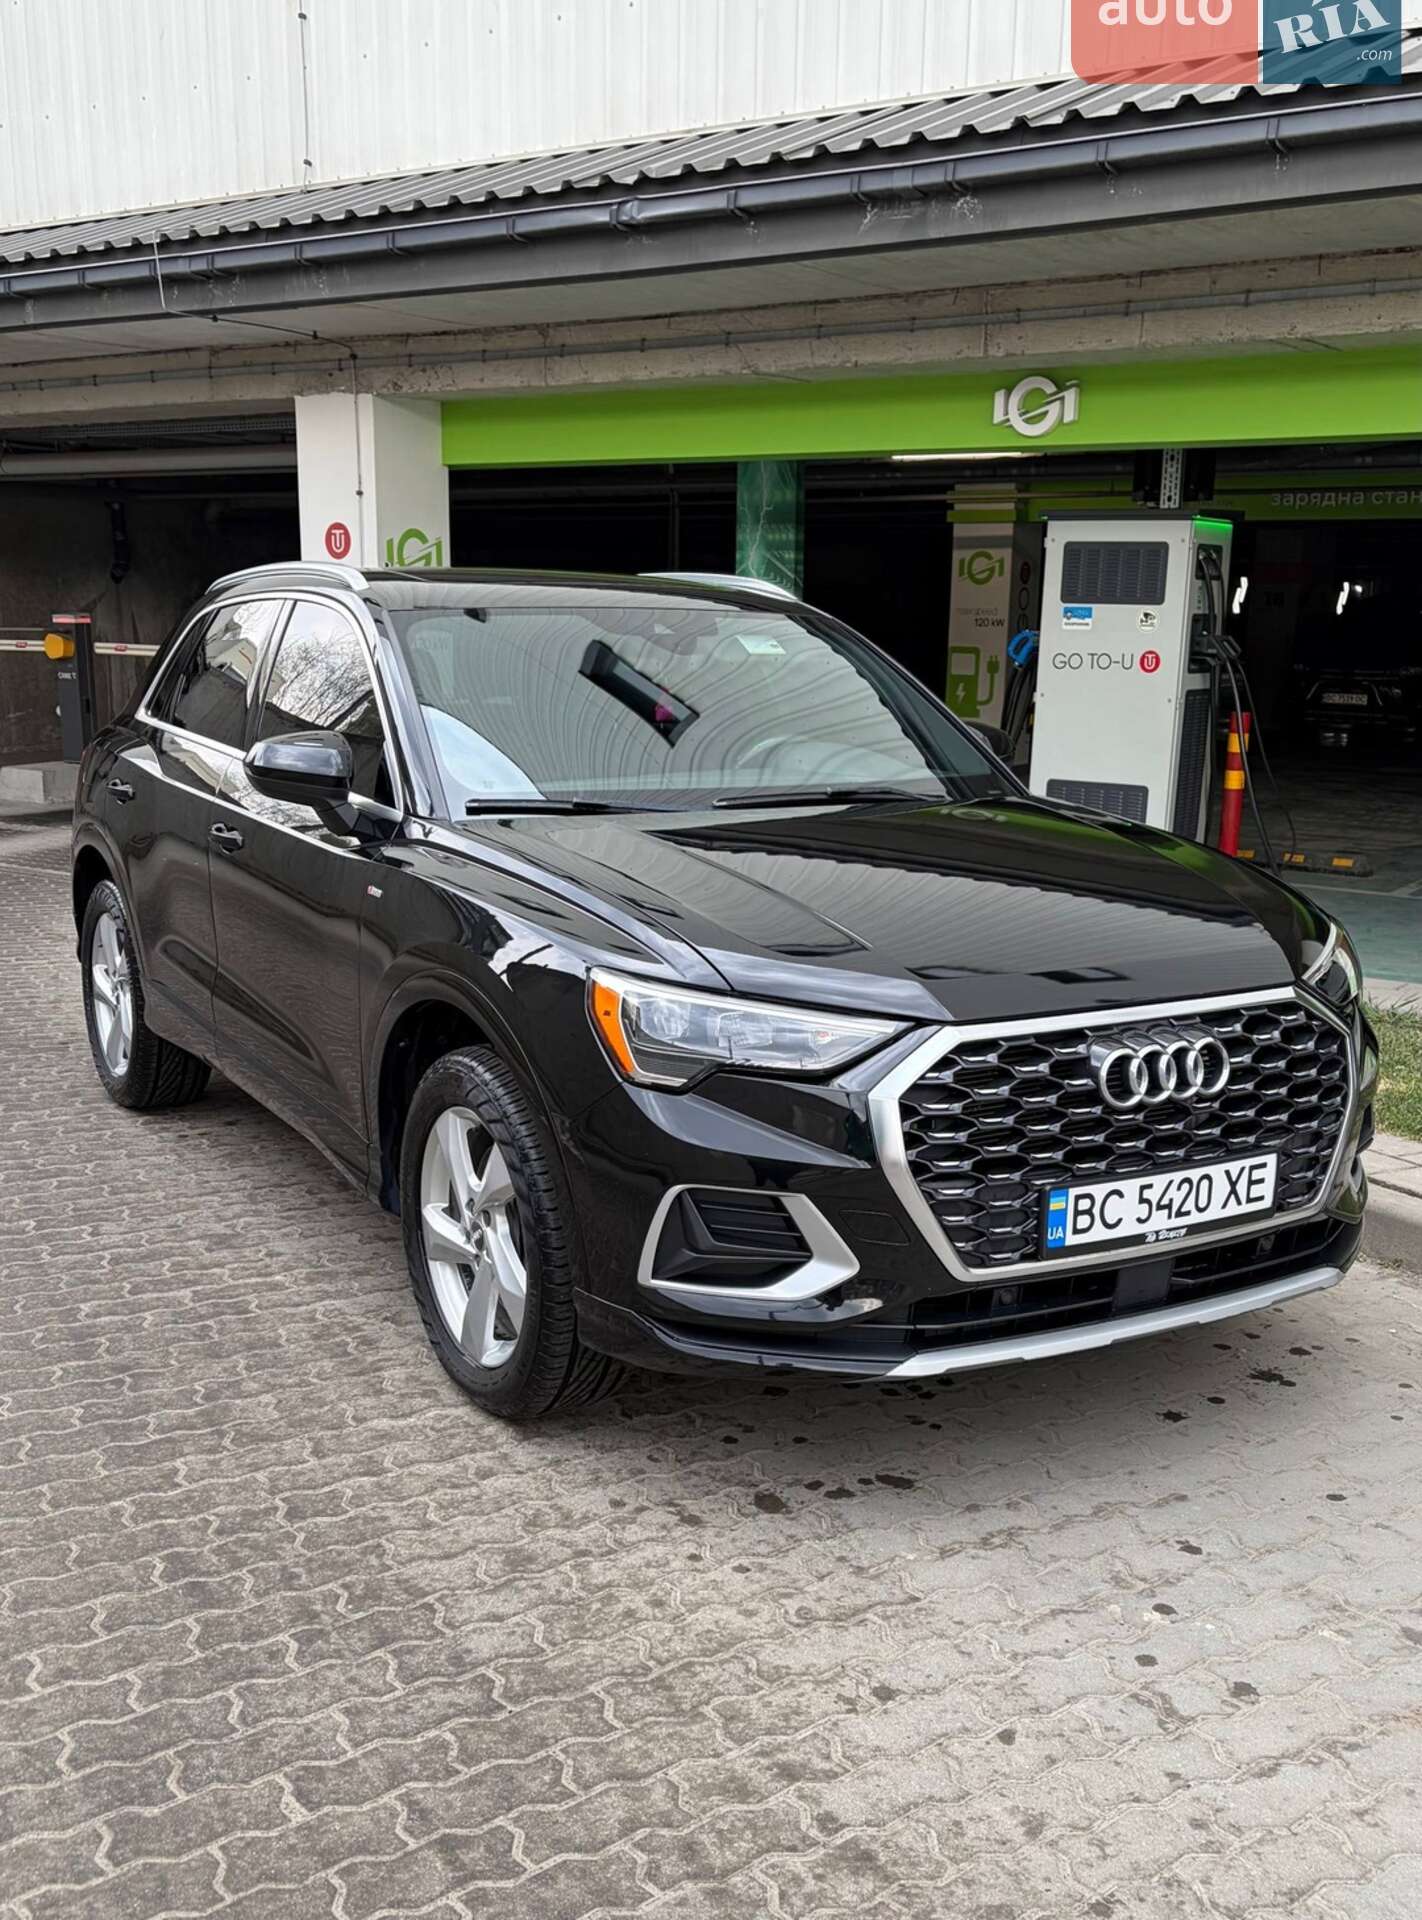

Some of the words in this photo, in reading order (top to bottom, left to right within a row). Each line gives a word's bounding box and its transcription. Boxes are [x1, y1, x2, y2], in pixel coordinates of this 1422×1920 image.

[1271, 491, 1365, 509] зарядна
[974, 617, 990, 628] 120
[1052, 652, 1083, 671] GO
[1087, 652, 1135, 671] TO-U
[1071, 1188, 1126, 1236] BC
[1135, 1173, 1214, 1225] 5420
[1220, 1161, 1269, 1210] XE
[1048, 1227, 1065, 1241] UA
